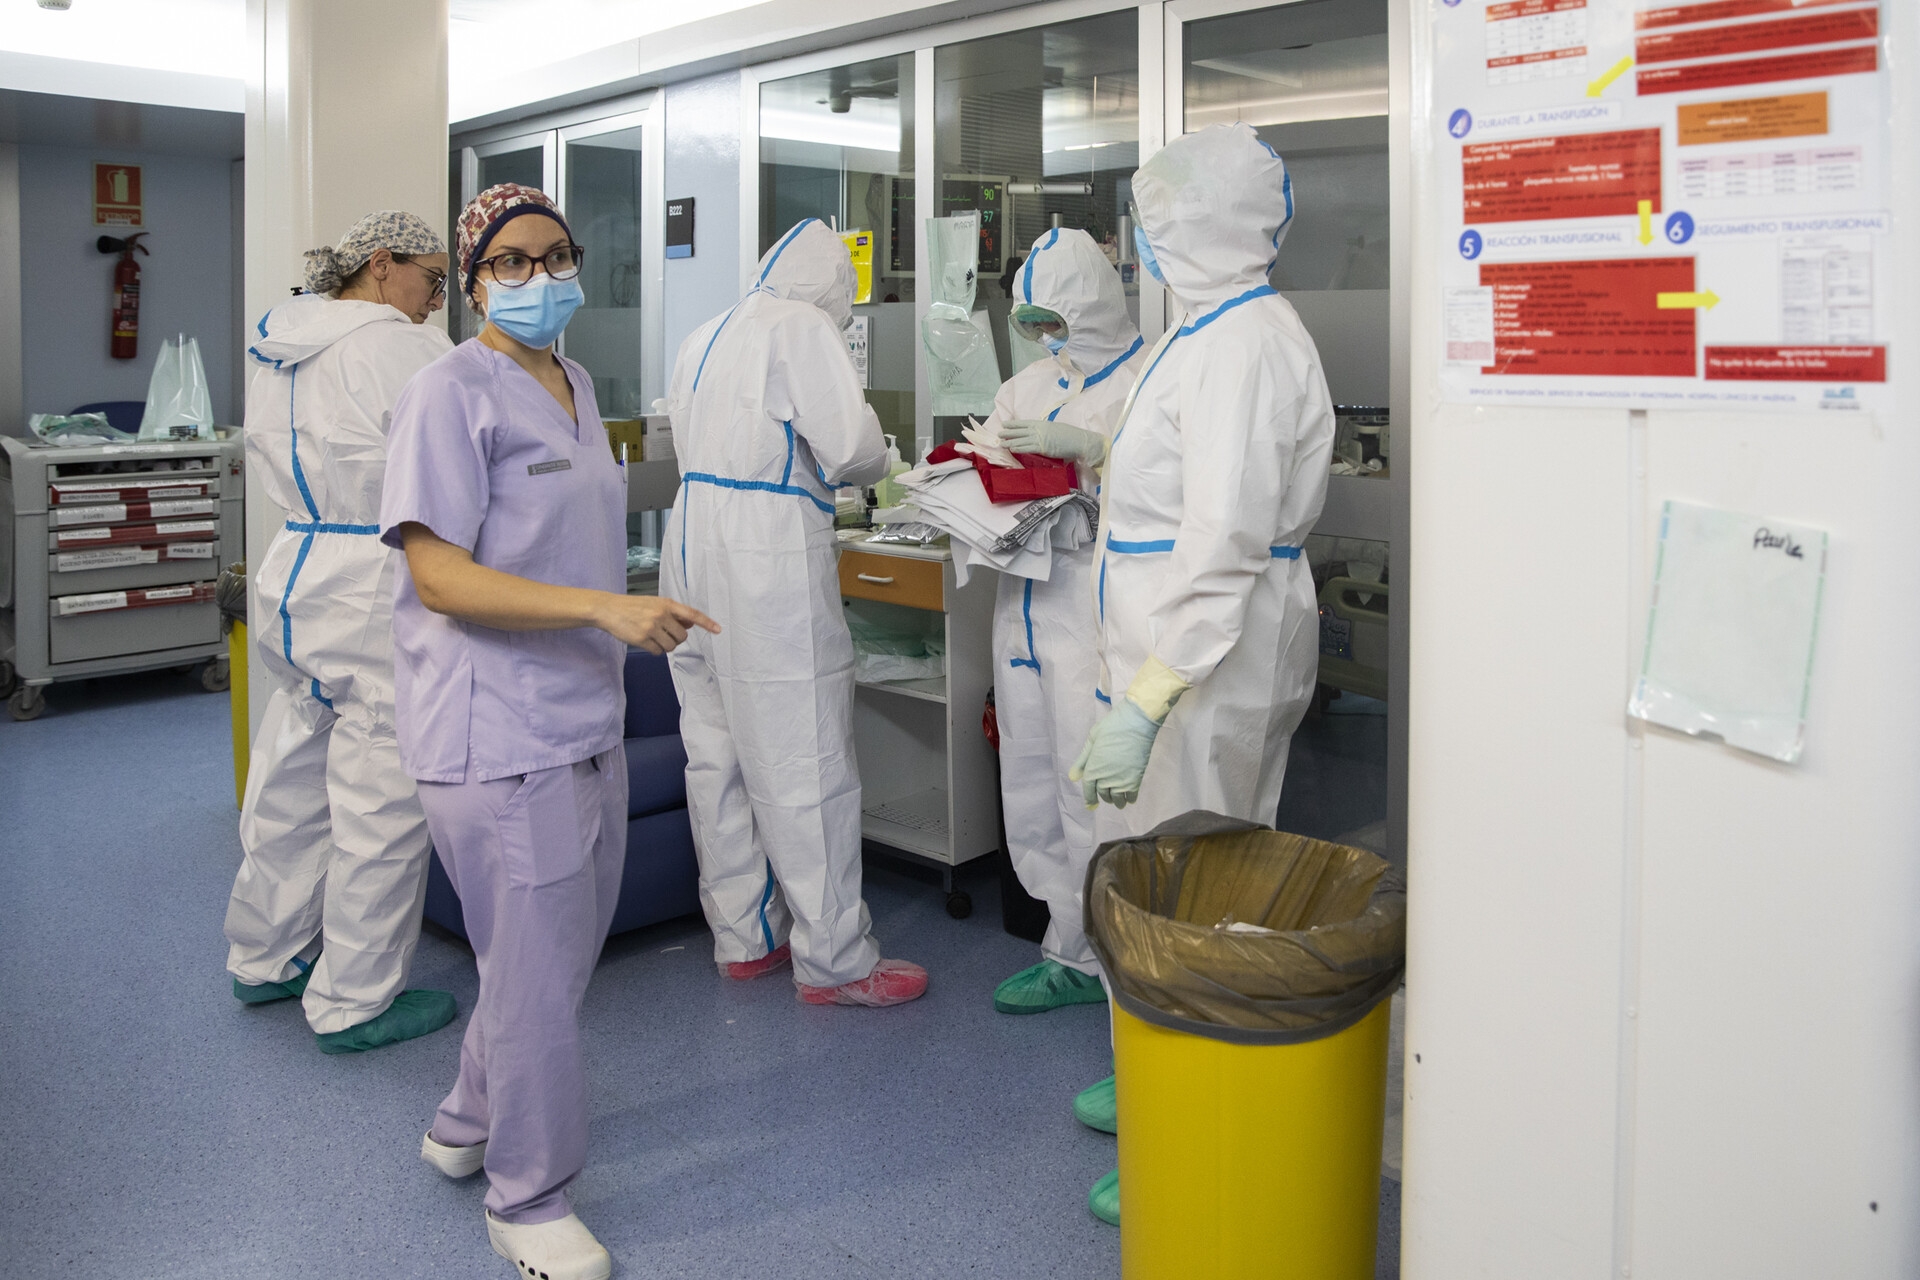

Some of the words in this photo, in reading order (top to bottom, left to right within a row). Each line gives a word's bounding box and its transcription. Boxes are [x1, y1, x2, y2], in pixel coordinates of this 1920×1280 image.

[1477, 113, 1521, 130] DURANTE
[983, 188, 995, 201] 90
[1668, 219, 1685, 242] 6
[1697, 221, 1778, 237] SEGUIMIENTO
[1780, 216, 1884, 232] TRANSFUSIONAL
[1462, 238, 1475, 258] 5
[1486, 233, 1537, 248] REACCIÓN
[1539, 231, 1622, 245] TRANSFUSIONAL
